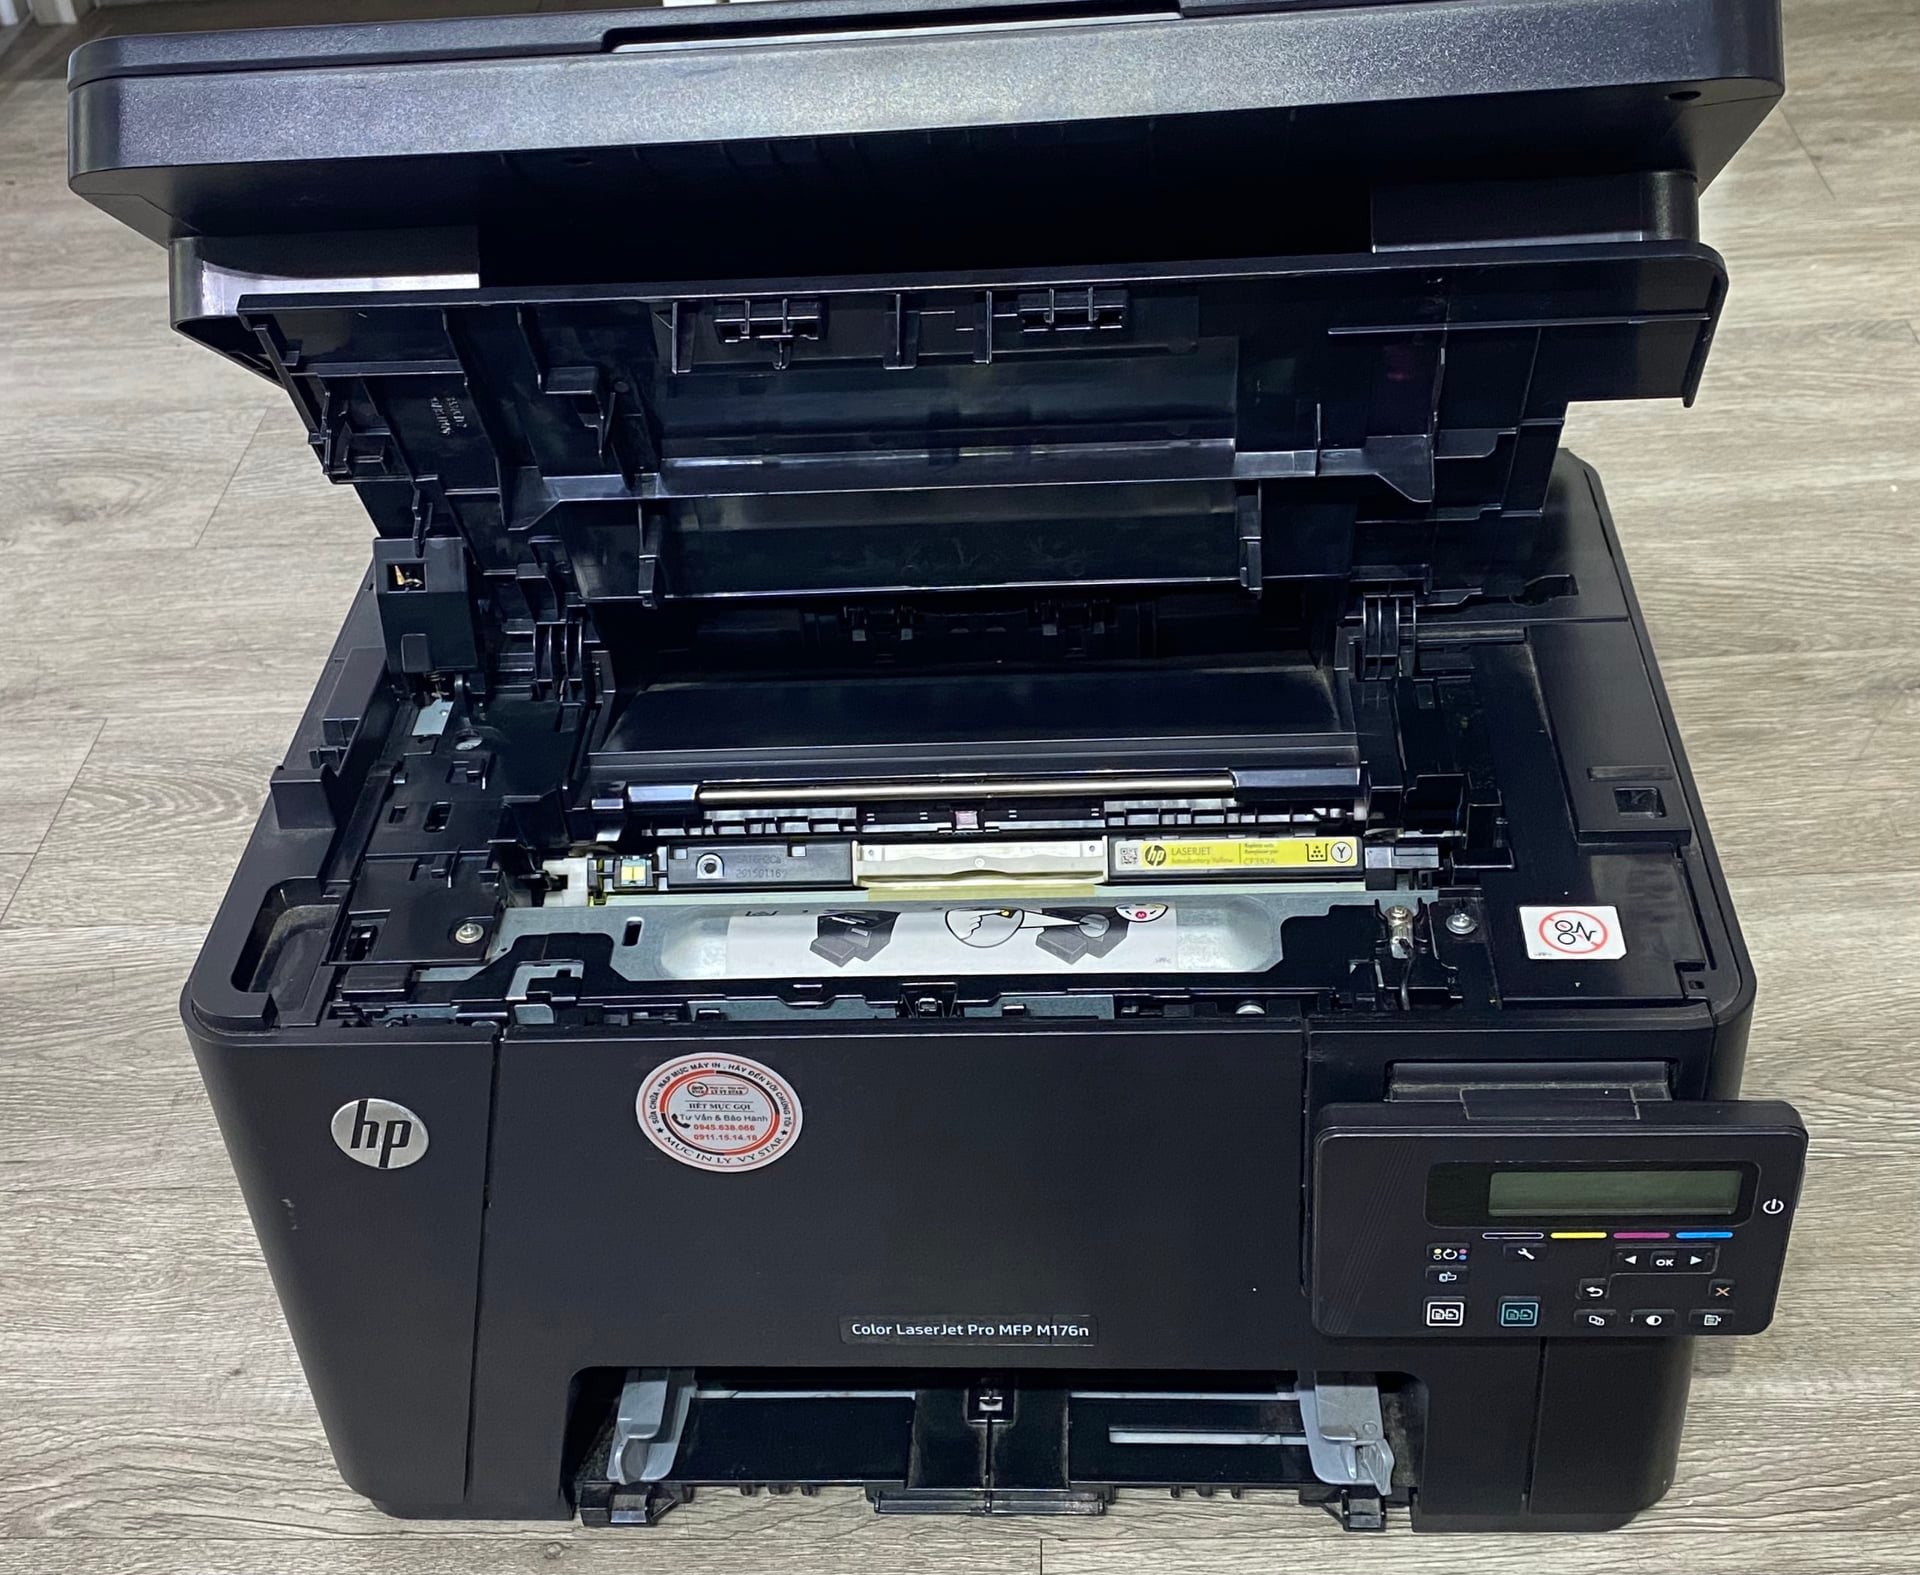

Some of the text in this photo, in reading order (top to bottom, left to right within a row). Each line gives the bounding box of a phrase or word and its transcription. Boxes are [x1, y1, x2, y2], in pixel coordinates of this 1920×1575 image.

[1171, 846, 1211, 856] LASERJET
[1337, 846, 1346, 859] Y
[715, 1114, 722, 1122] &
[350, 1099, 412, 1168] hp
[695, 1152, 712, 1162] IN
[737, 1153, 756, 1163] VY
[757, 1137, 784, 1157] STAR
[1655, 1258, 1674, 1267] OK
[851, 1322, 1089, 1337] Color LaserJet Pro MFP M176n
